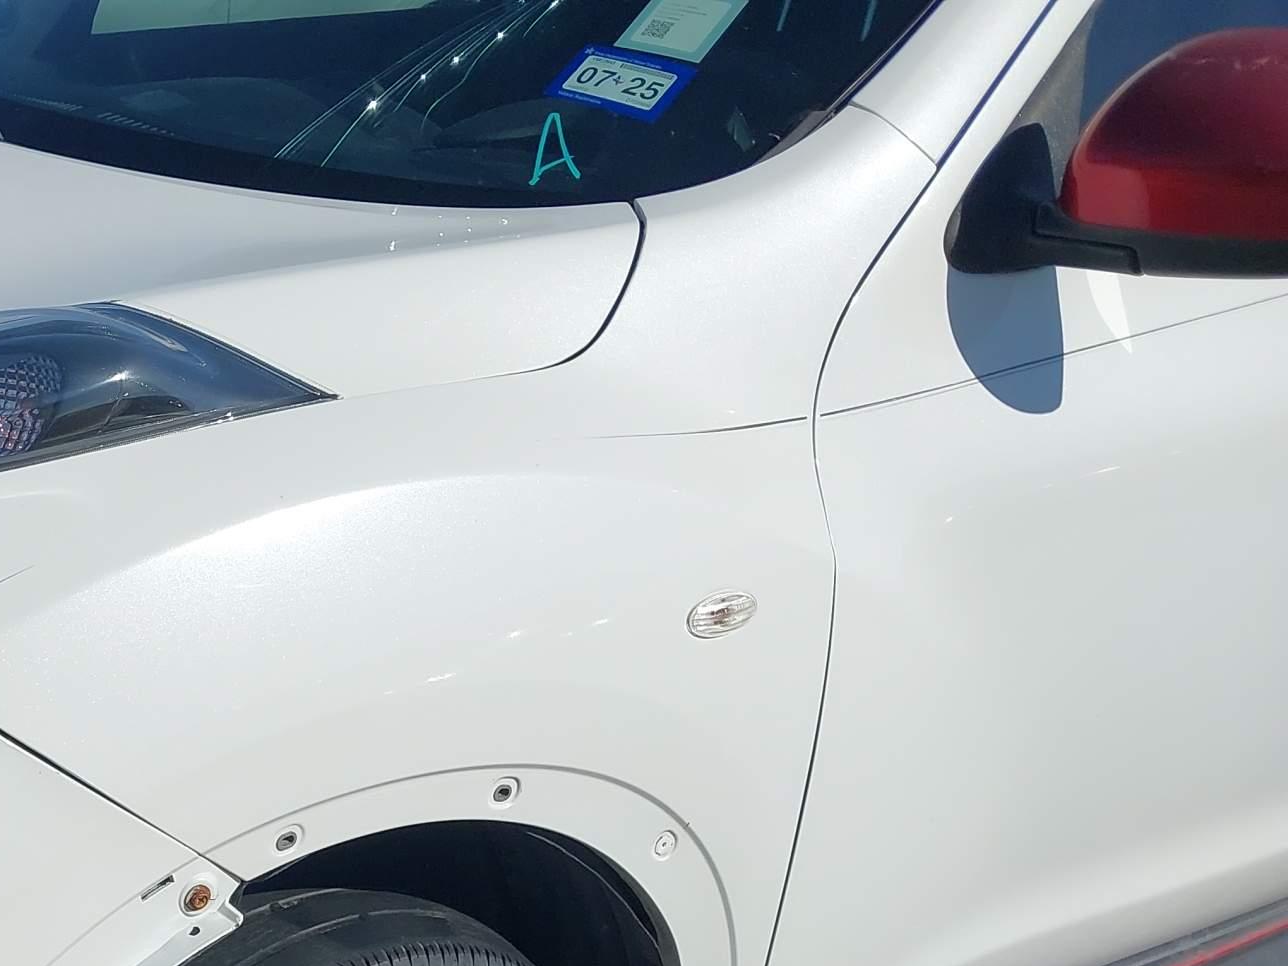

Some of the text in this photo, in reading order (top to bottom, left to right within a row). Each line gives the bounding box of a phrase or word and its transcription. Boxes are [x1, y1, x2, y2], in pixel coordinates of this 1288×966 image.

[575, 66, 617, 88] 07
[622, 77, 666, 102] 25
[528, 112, 583, 186] A
